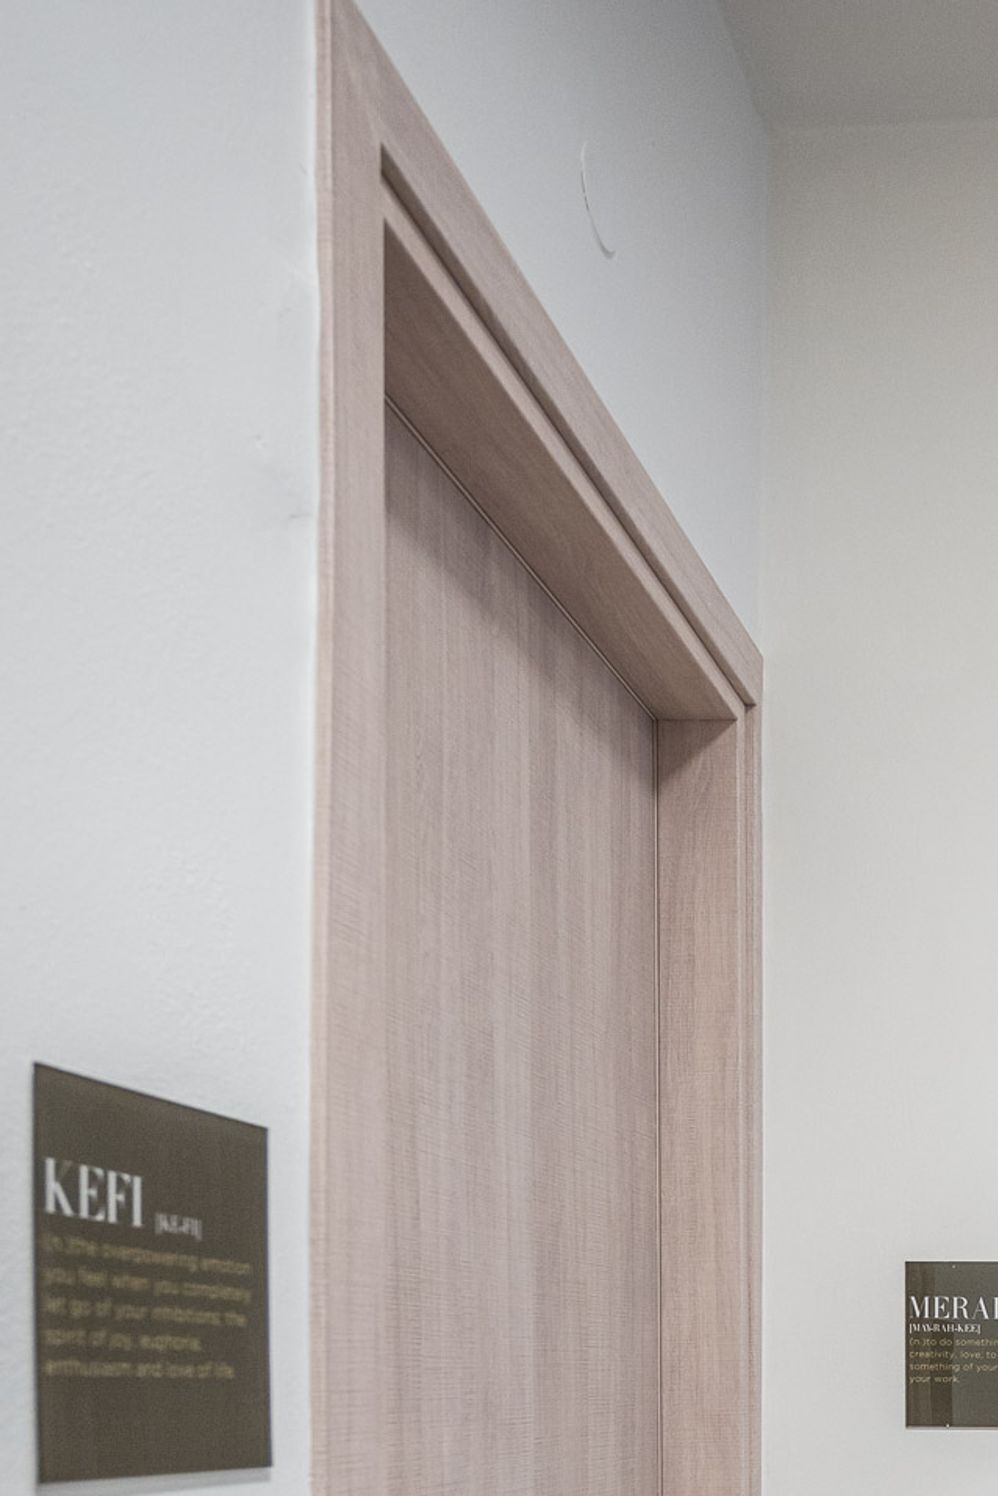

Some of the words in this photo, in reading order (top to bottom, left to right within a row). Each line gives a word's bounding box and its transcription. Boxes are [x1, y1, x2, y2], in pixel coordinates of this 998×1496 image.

[43, 1156, 145, 1229] KEFI
[939, 1337, 952, 1346] do
[986, 1351, 996, 1359] to
[909, 1363, 960, 1373] something
[962, 1363, 973, 1372] of
[908, 1375, 931, 1384] your
